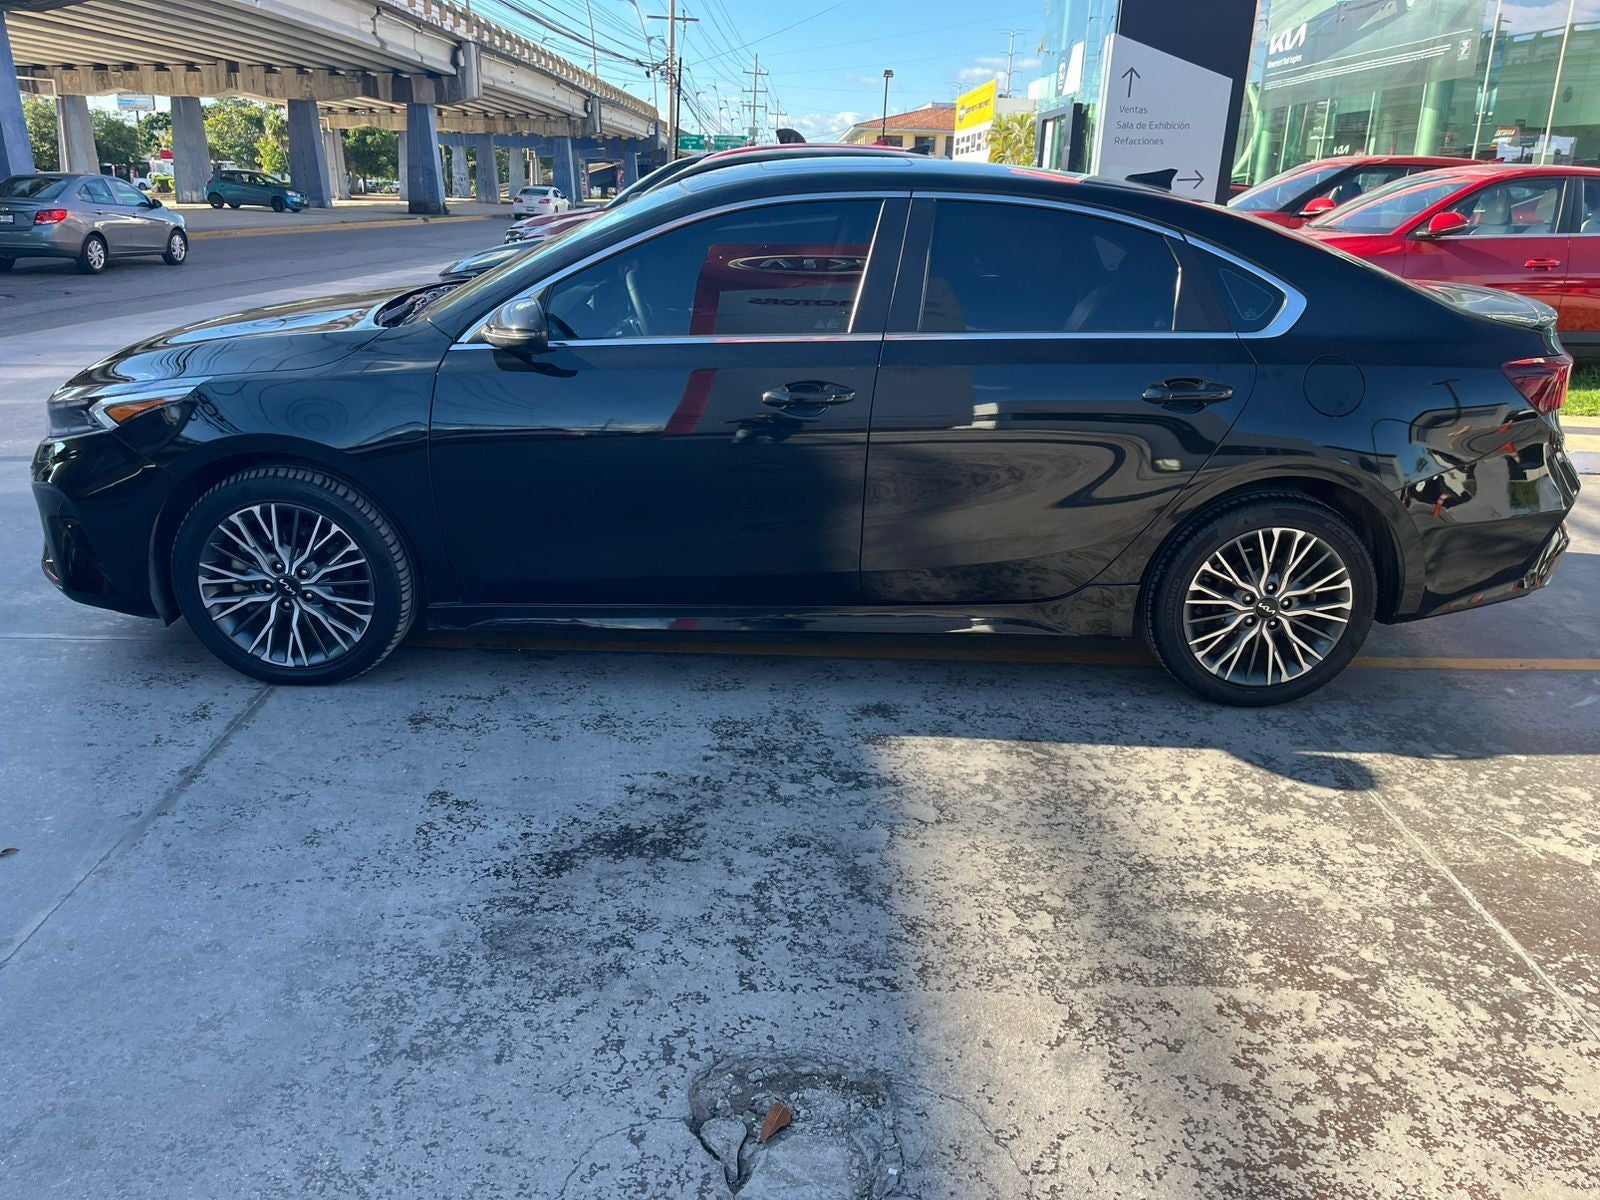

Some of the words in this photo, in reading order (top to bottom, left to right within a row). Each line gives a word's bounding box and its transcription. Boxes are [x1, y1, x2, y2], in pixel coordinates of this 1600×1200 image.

[1268, 22, 1307, 55] KIA
[1119, 104, 1148, 114] Ventas
[1116, 120, 1134, 130] Sala
[1136, 120, 1147, 130] de
[1148, 120, 1190, 130] Exhibición
[1113, 136, 1164, 146] Refacciones
